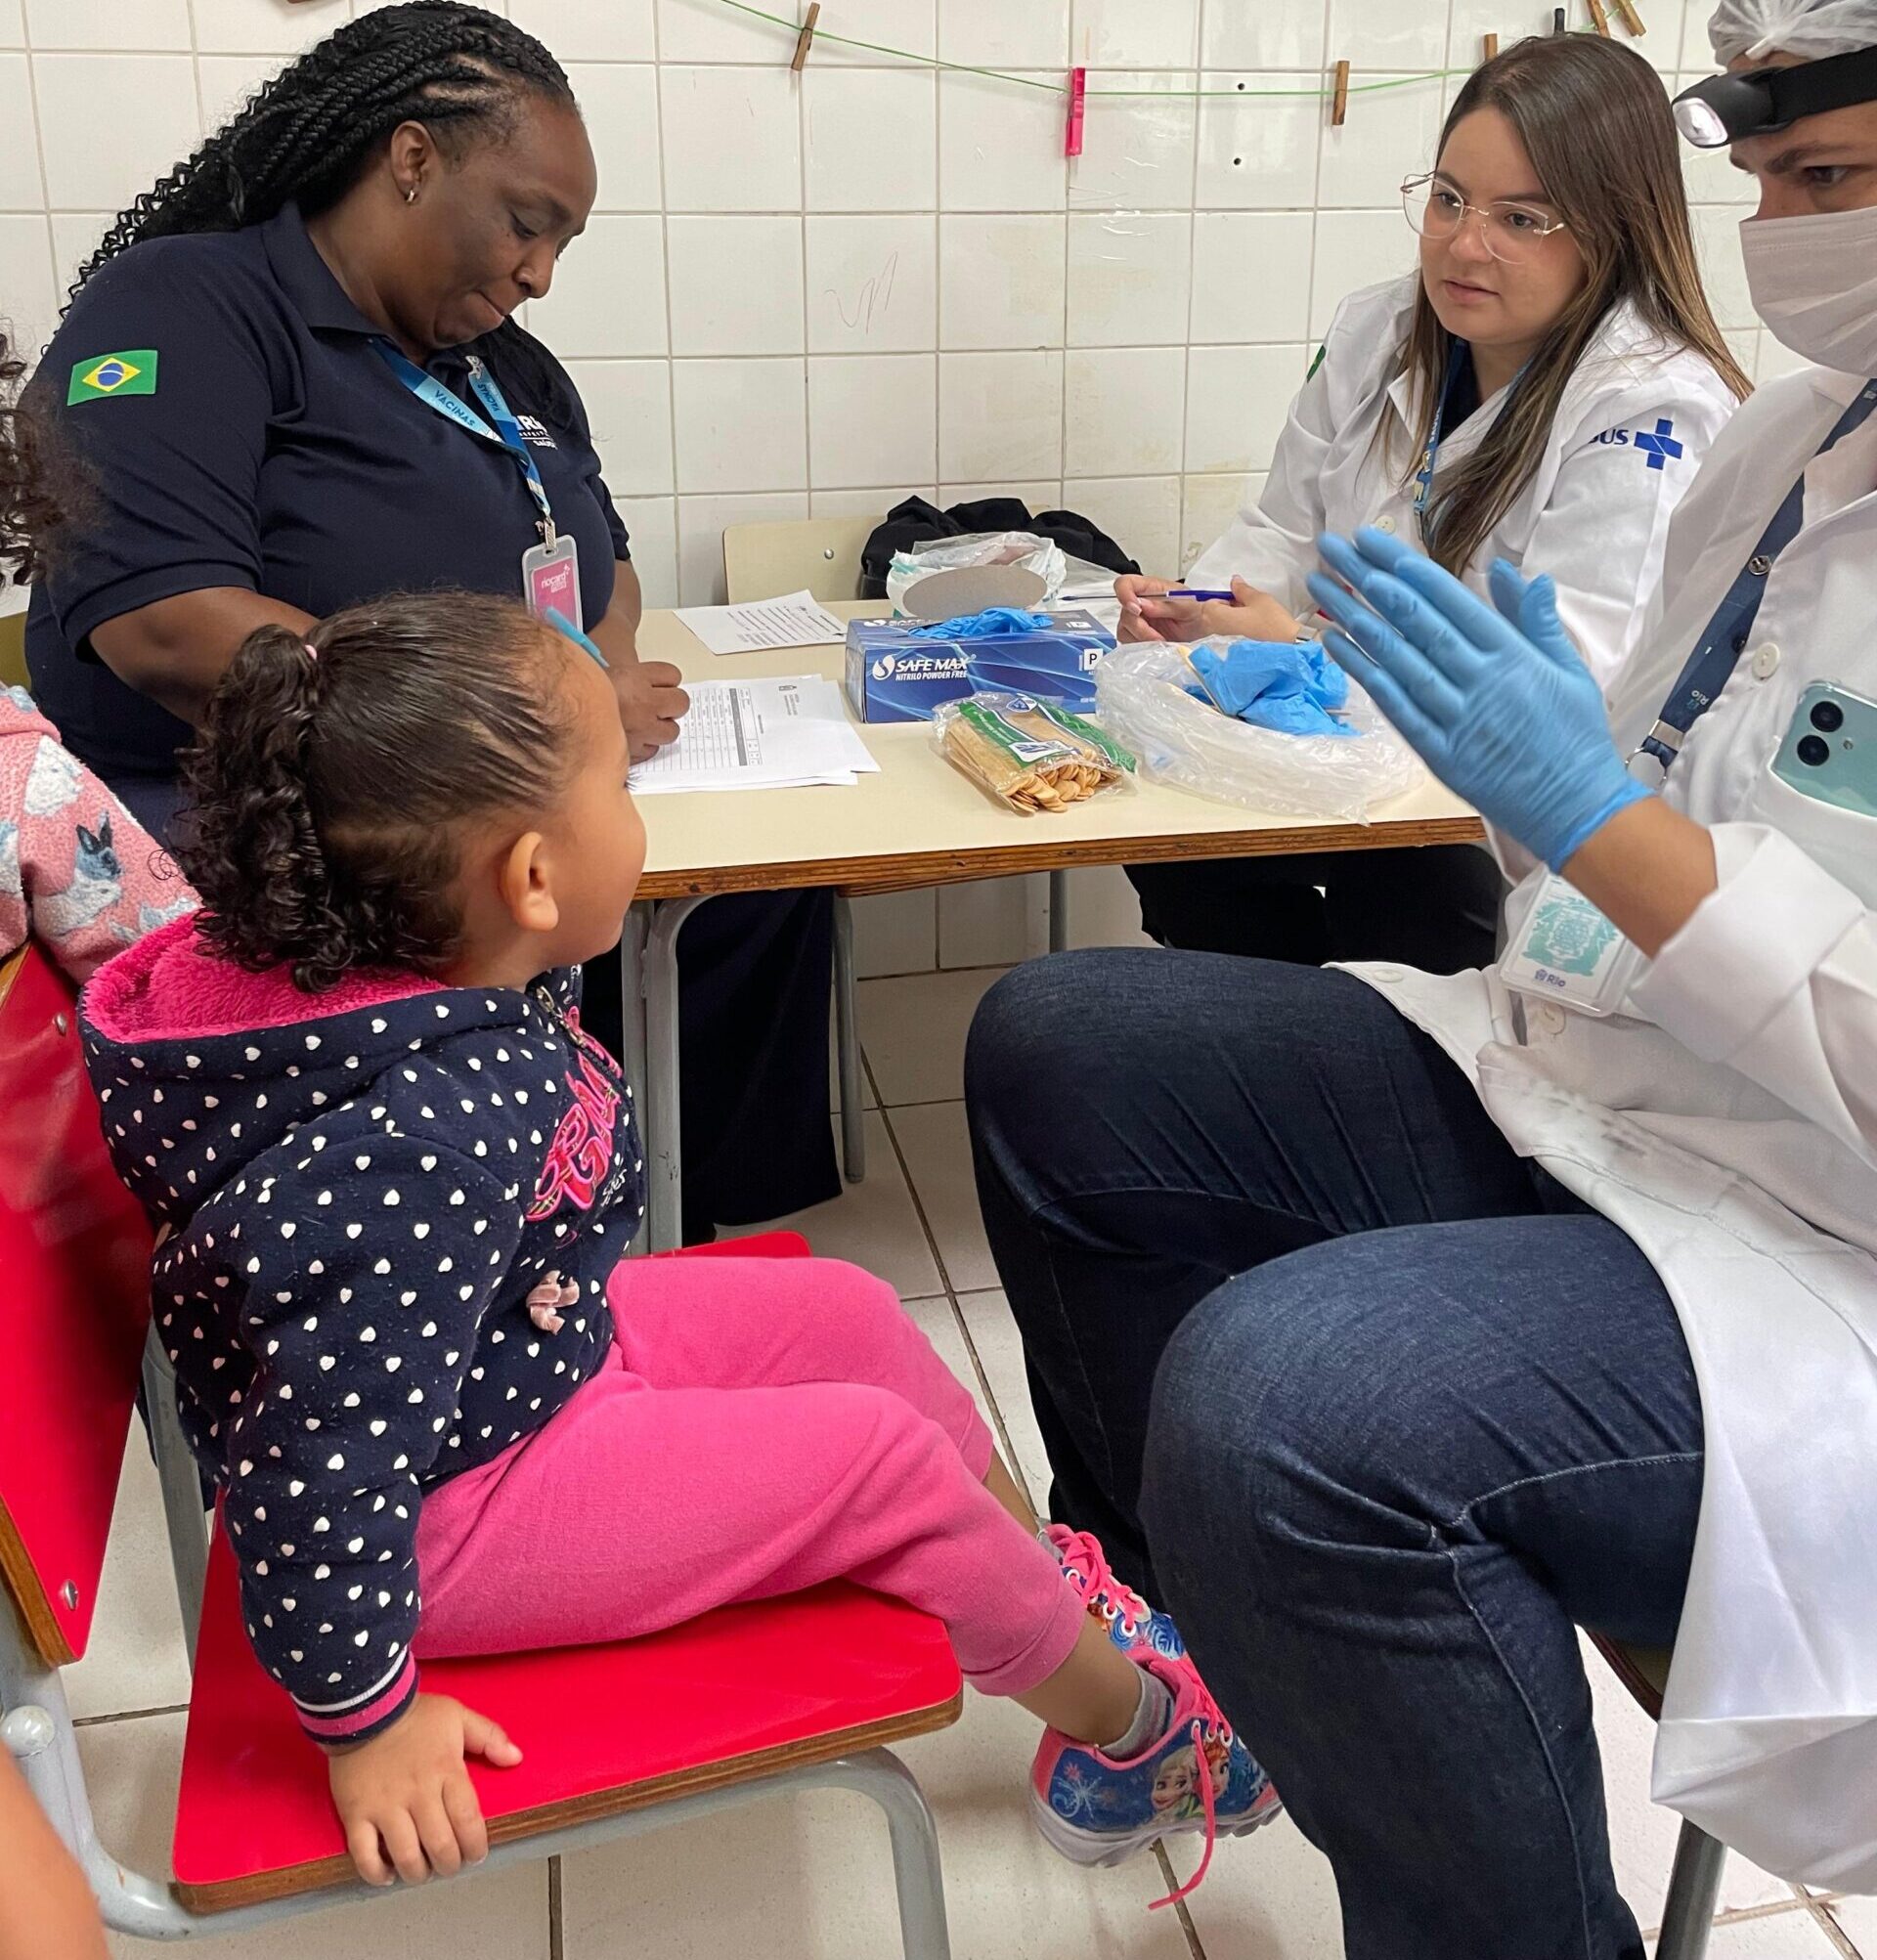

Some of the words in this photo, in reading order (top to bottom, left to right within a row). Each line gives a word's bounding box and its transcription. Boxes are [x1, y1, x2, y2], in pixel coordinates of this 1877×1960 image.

[434, 389, 476, 426] VACINAS
[895, 658, 934, 673] SAFE
[934, 657, 969, 672] MAX
[1088, 653, 1098, 665] P
[895, 672, 922, 681] NITRILO
[922, 671, 950, 680] POWDER
[950, 669, 968, 678] FREE
[1546, 974, 1566, 987] Rio
